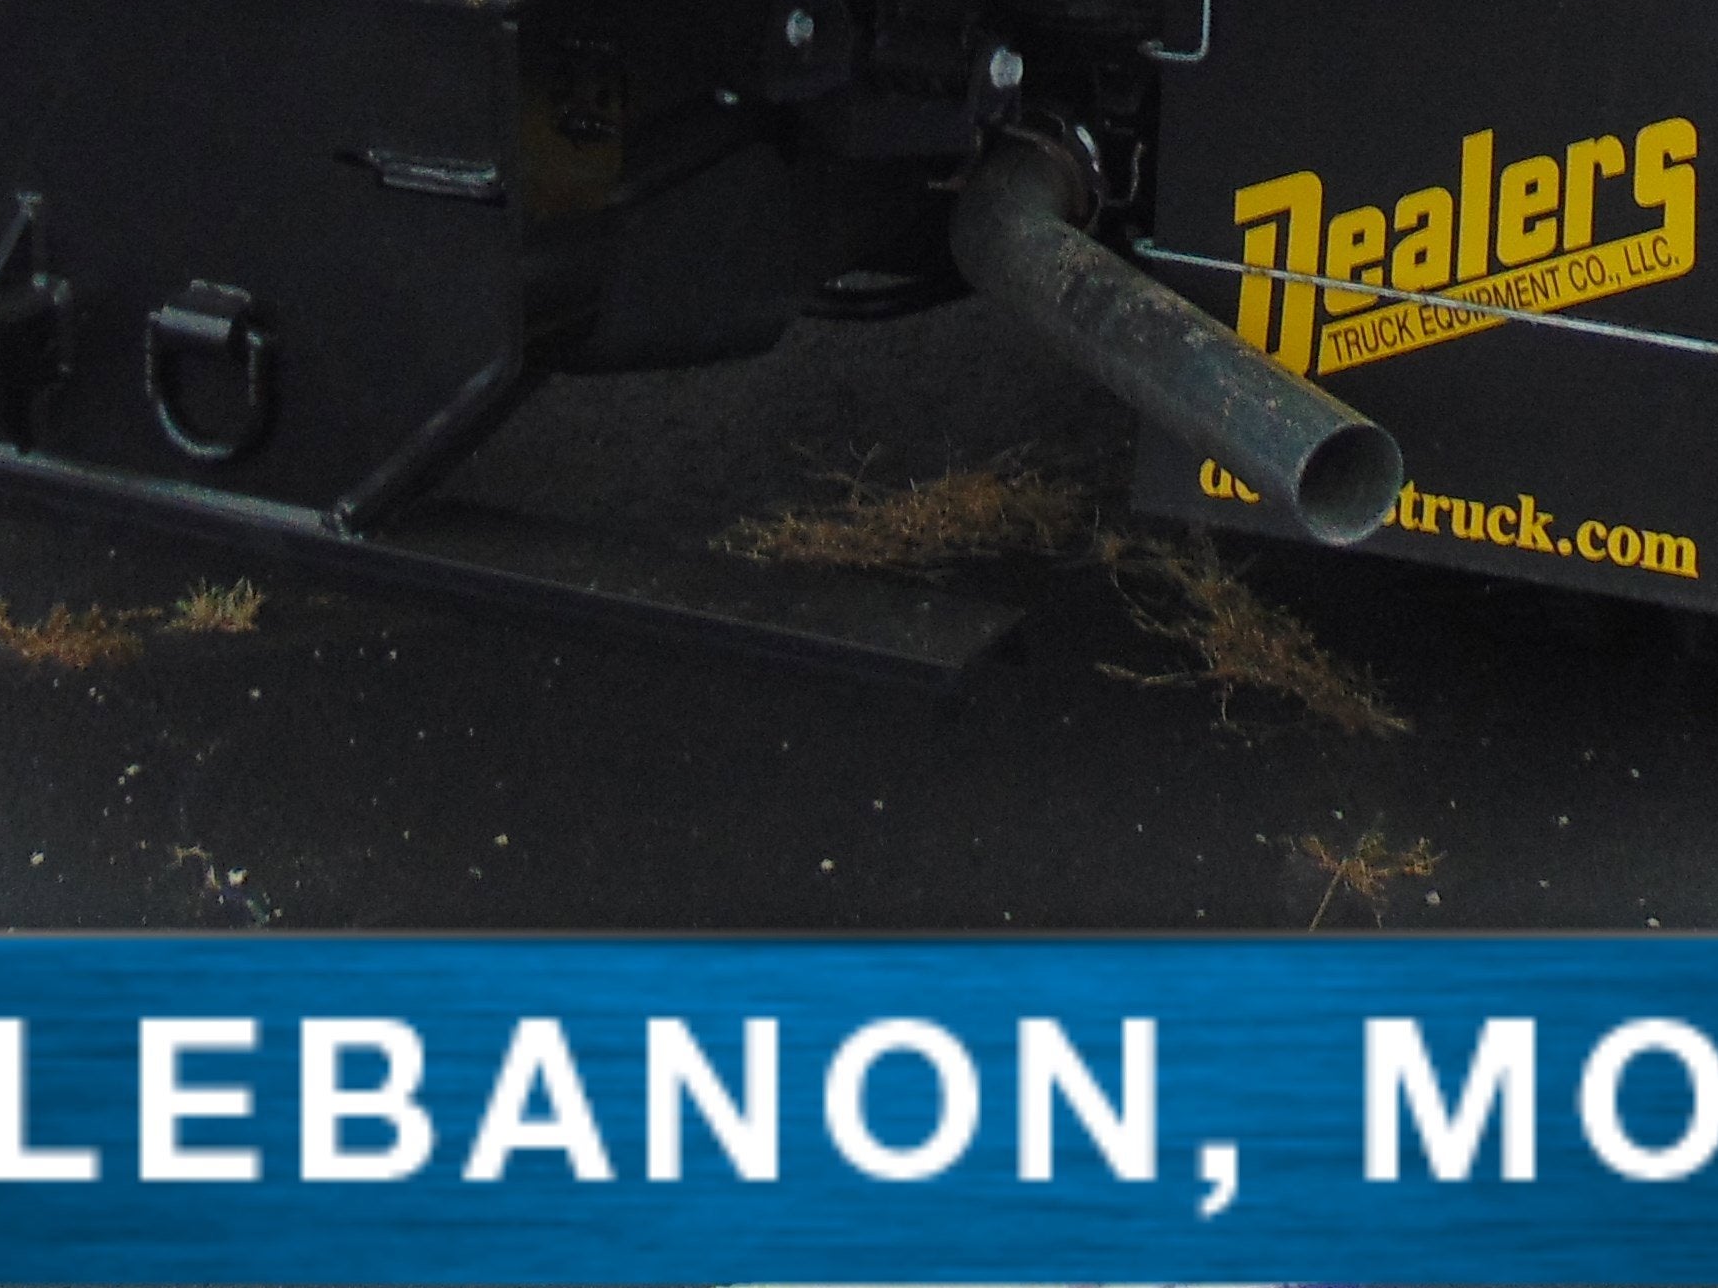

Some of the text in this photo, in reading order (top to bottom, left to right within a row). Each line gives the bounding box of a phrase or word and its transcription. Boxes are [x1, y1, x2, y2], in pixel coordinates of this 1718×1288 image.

[1233, 116, 1699, 381] Dealers
[1327, 238, 1681, 363] TRUCK EQUIPMENT CO., LLC.
